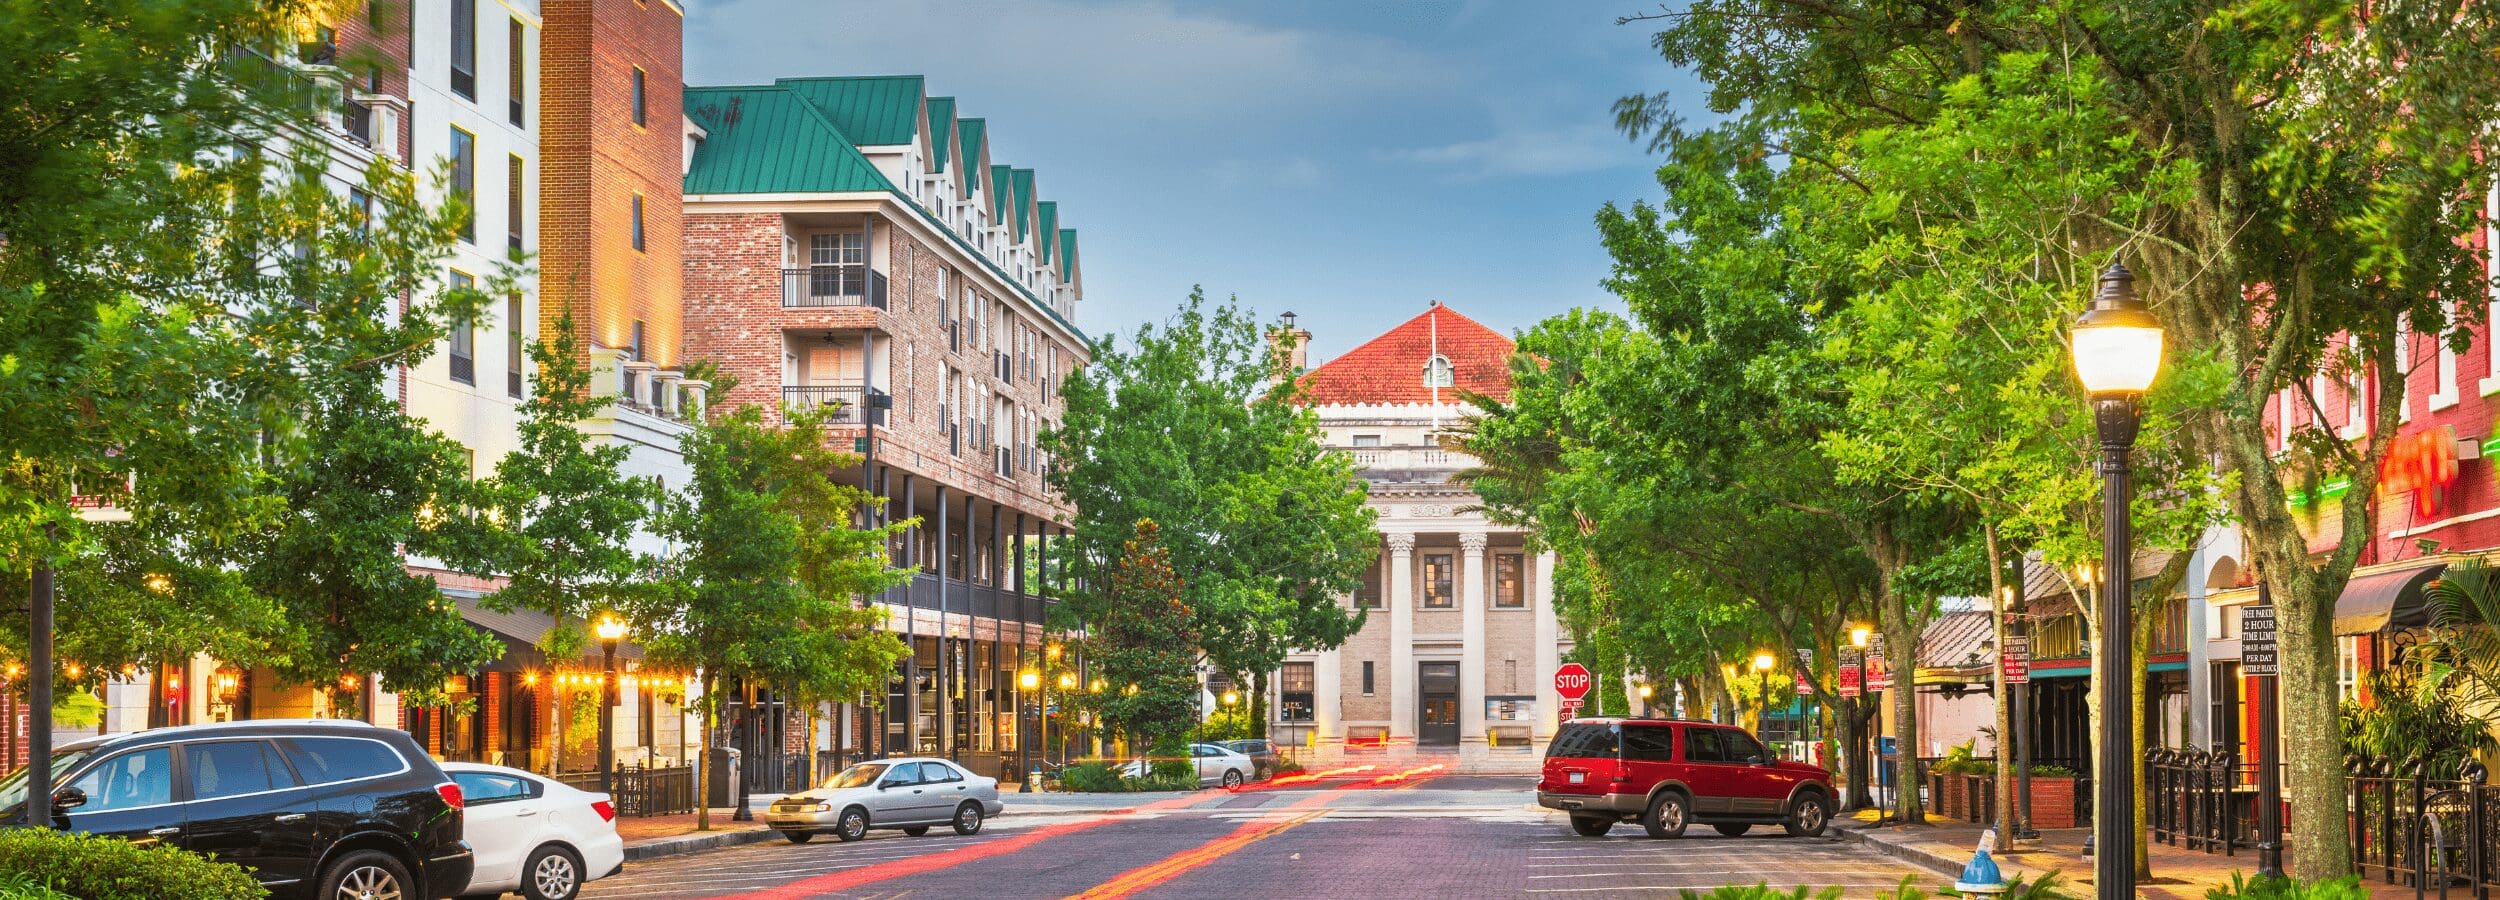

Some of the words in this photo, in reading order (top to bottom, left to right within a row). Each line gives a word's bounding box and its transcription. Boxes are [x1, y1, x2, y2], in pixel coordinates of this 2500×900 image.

[2242, 609, 2255, 618] FREE
[2255, 609, 2274, 618] PARKIN
[2244, 621, 2250, 630] 2
[2250, 620, 2275, 630] HOUR
[2242, 631, 2258, 641] TIME
[2246, 654, 2259, 662] PER
[2259, 654, 2273, 662] DAY
[1556, 674, 1588, 689] STOP
